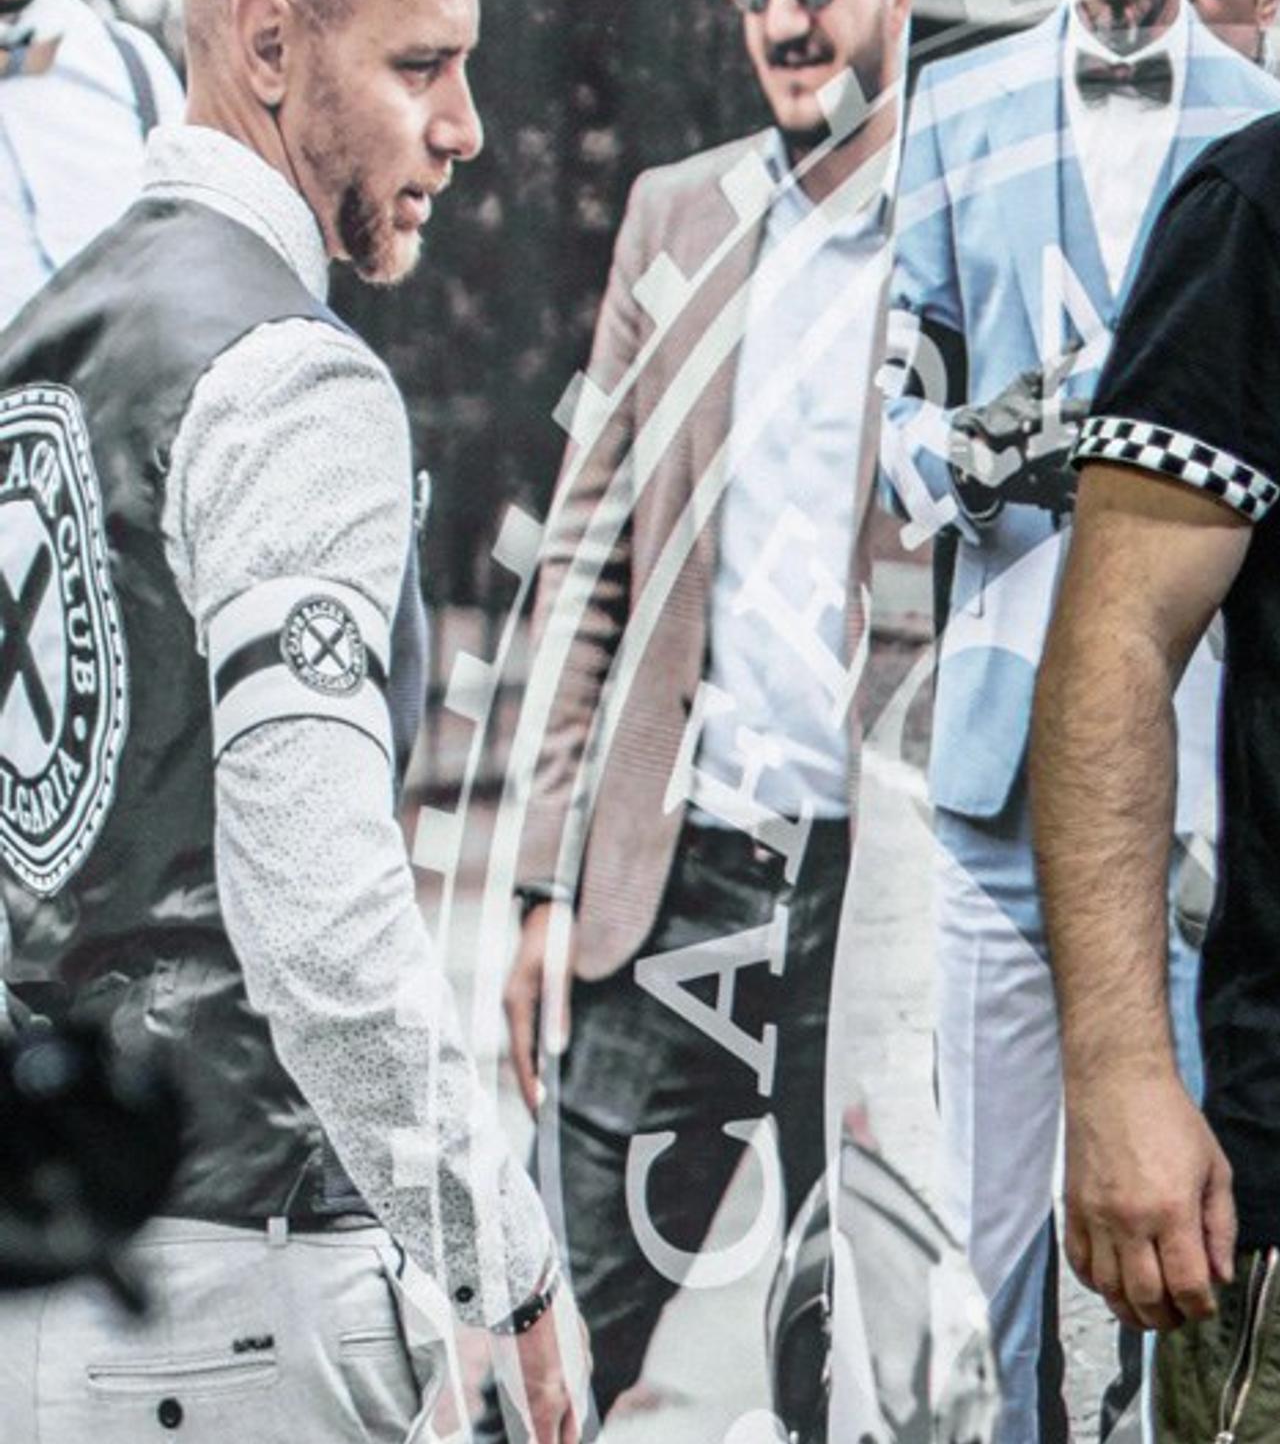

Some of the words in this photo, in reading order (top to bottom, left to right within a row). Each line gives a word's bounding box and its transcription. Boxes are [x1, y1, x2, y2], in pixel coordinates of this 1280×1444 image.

[57, 513, 97, 695] CLUB
[0, 748, 84, 834] LGARIA
[624, 502, 871, 1293] CAFE
